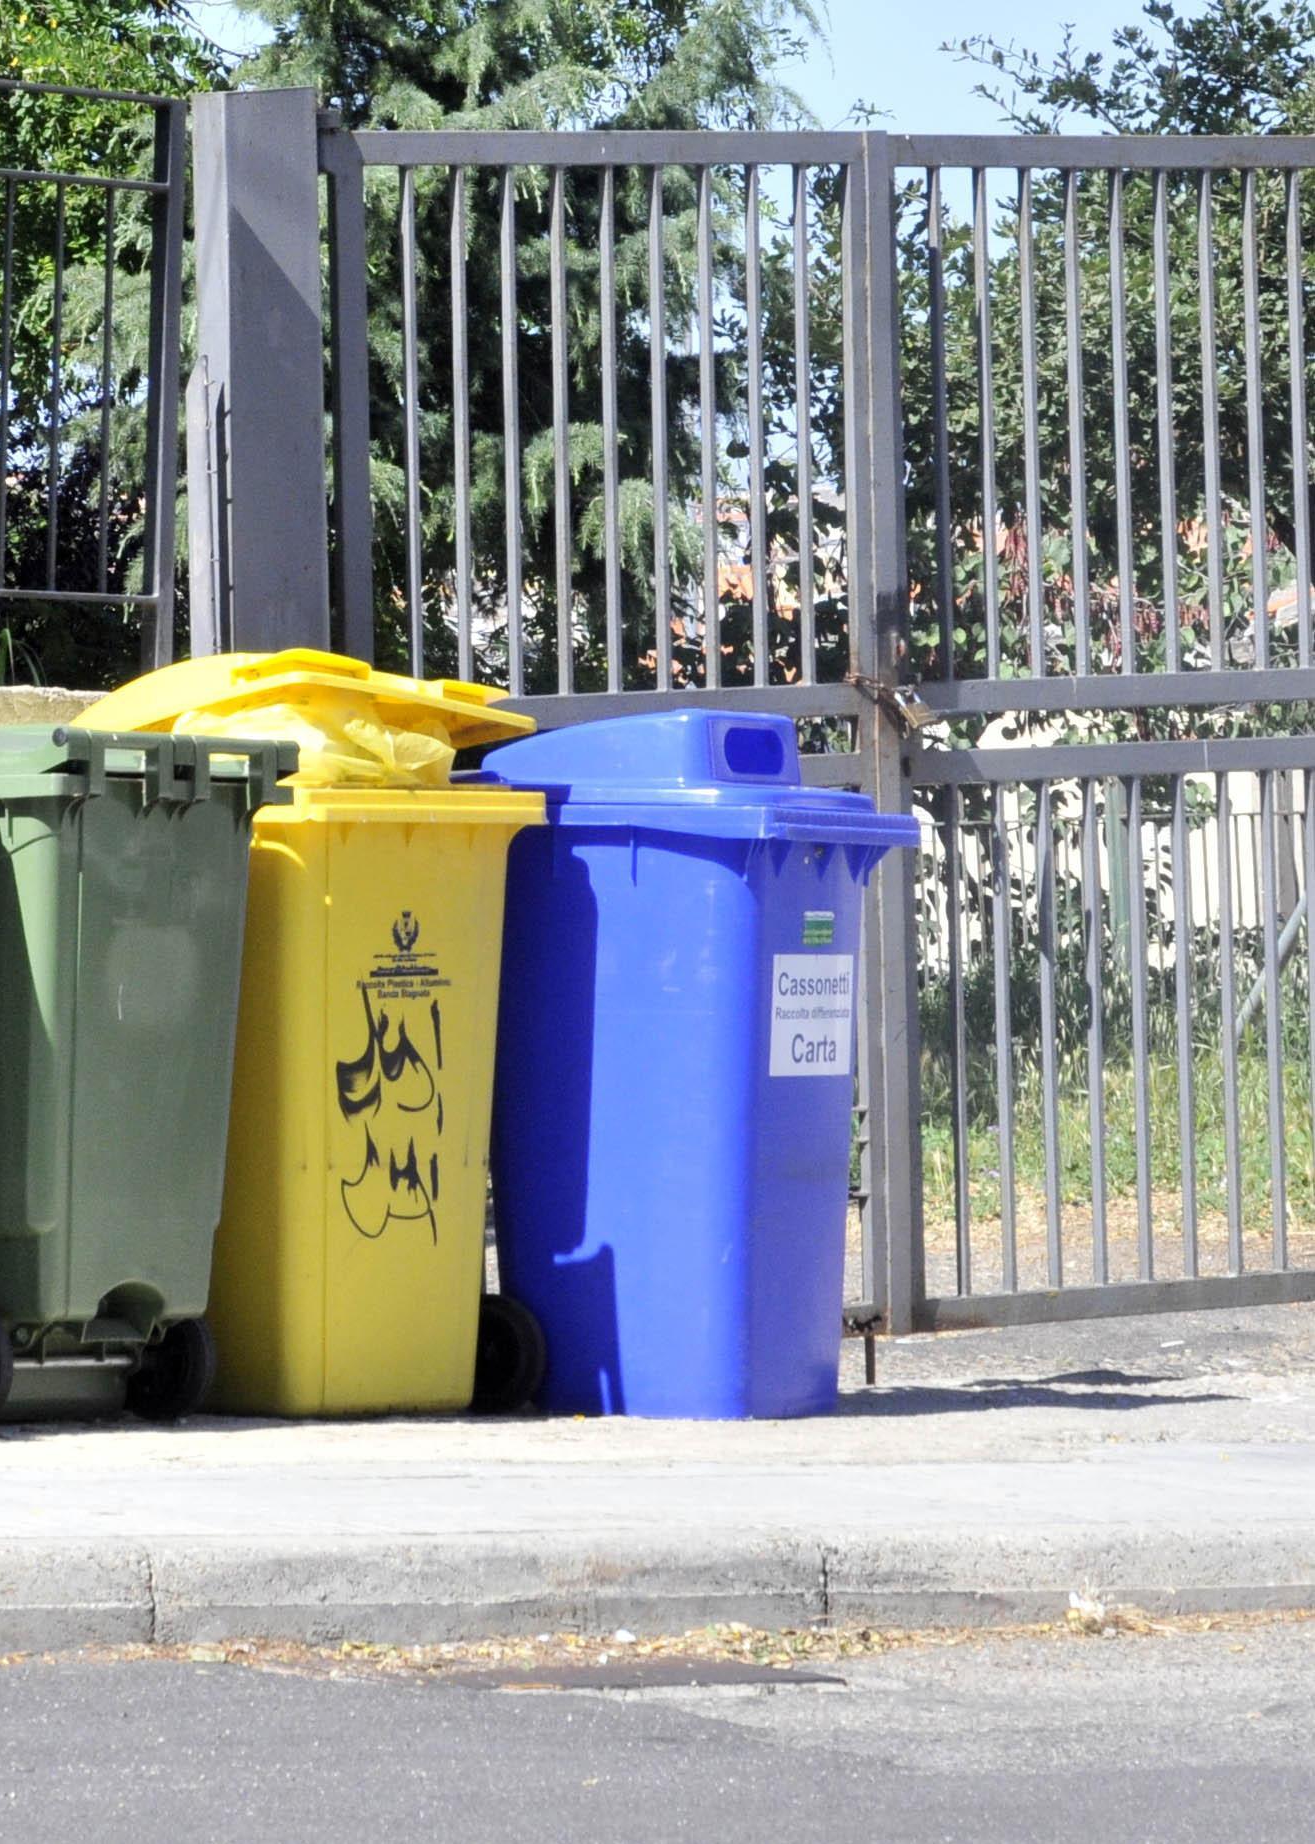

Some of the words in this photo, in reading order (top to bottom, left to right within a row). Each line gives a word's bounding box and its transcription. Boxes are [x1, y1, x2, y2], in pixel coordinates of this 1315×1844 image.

[778, 971, 850, 996] Cassonetti
[775, 1007, 810, 1020] Raccolta
[791, 1033, 837, 1064] Carta
